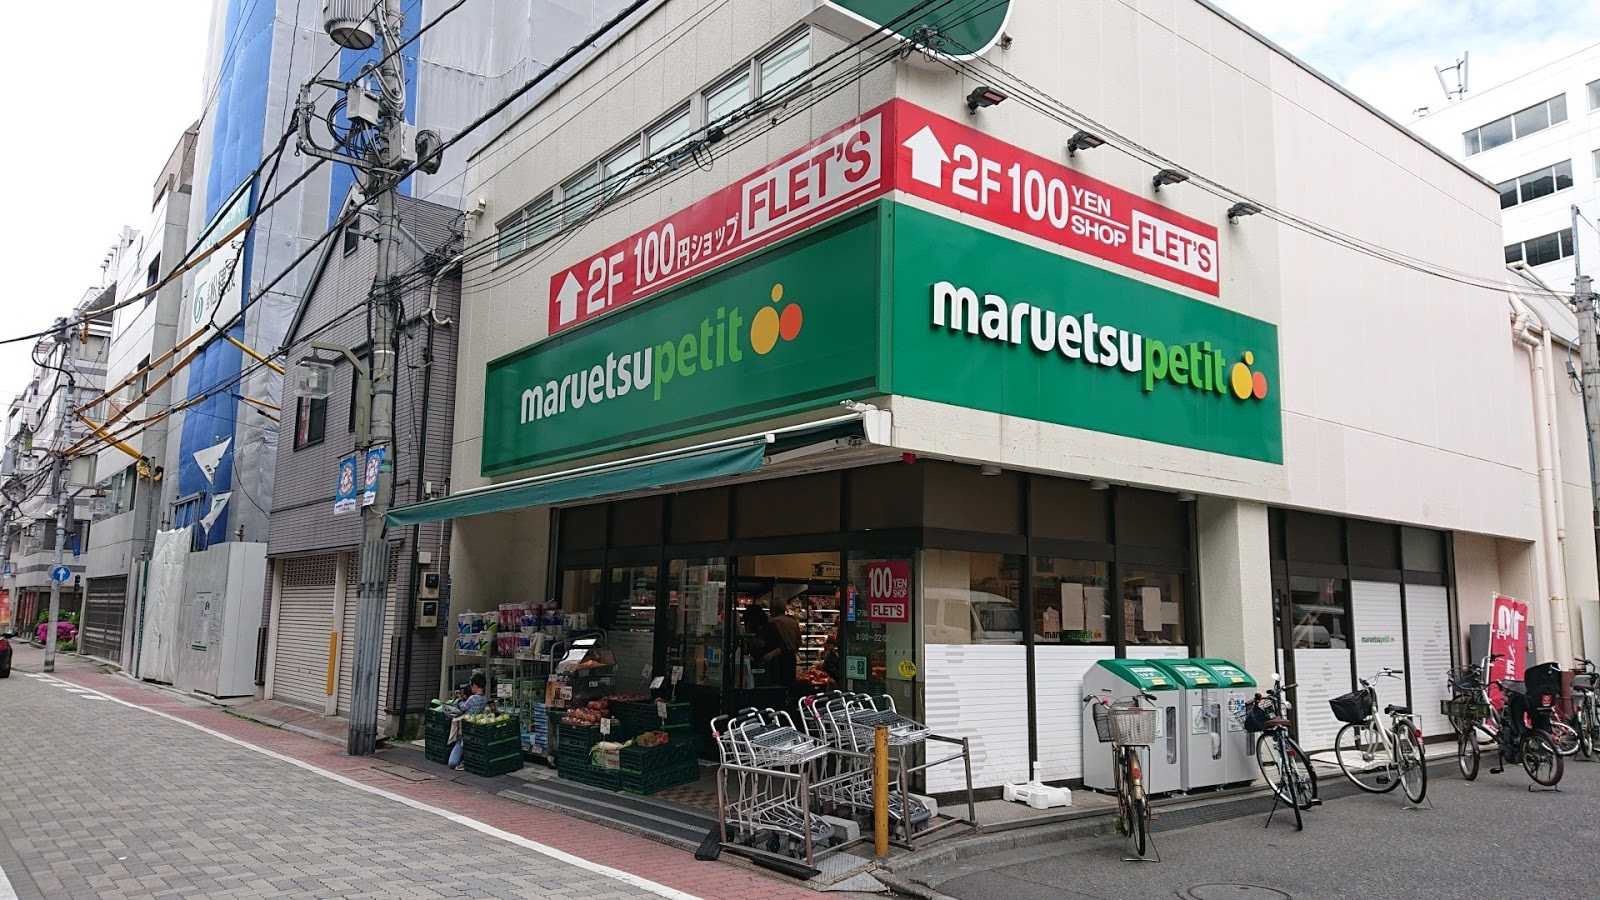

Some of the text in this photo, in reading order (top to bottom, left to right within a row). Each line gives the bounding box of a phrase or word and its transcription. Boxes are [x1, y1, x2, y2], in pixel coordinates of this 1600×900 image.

[952, 144, 1111, 230] 2F 100 YEN
[586, 252, 625, 315] 2F
[748, 129, 872, 230] FLET'S
[1071, 217, 1212, 273] SHOP FLET'S
[869, 567, 908, 598] 100 YEN
[872, 605, 903, 617] FLET'S
